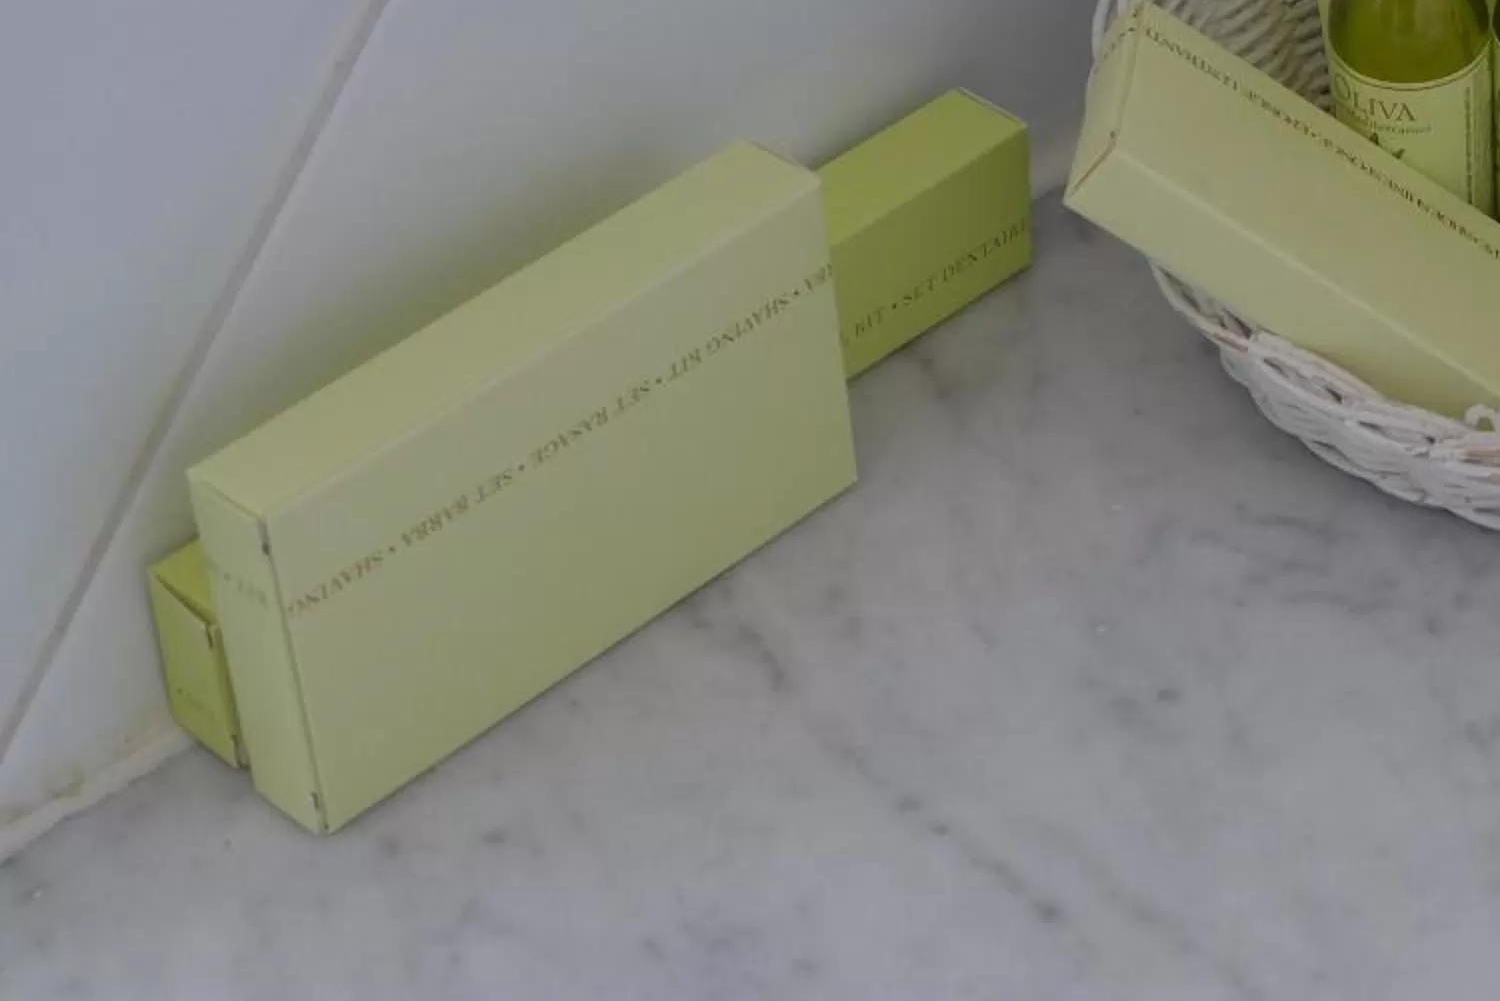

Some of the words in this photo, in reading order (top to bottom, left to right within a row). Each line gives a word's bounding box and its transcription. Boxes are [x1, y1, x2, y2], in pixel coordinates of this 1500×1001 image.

[1333, 72, 1416, 121] OLIVA
[704, 293, 792, 359] SHAVING
[853, 305, 889, 344] KIT
[901, 276, 939, 311] SET
[666, 345, 703, 386] KIT
[610, 376, 653, 418] SET
[529, 405, 610, 468] RASAGE
[473, 463, 515, 504] SET
[400, 498, 470, 549] BARBA
[288, 552, 385, 618] SHAVING
